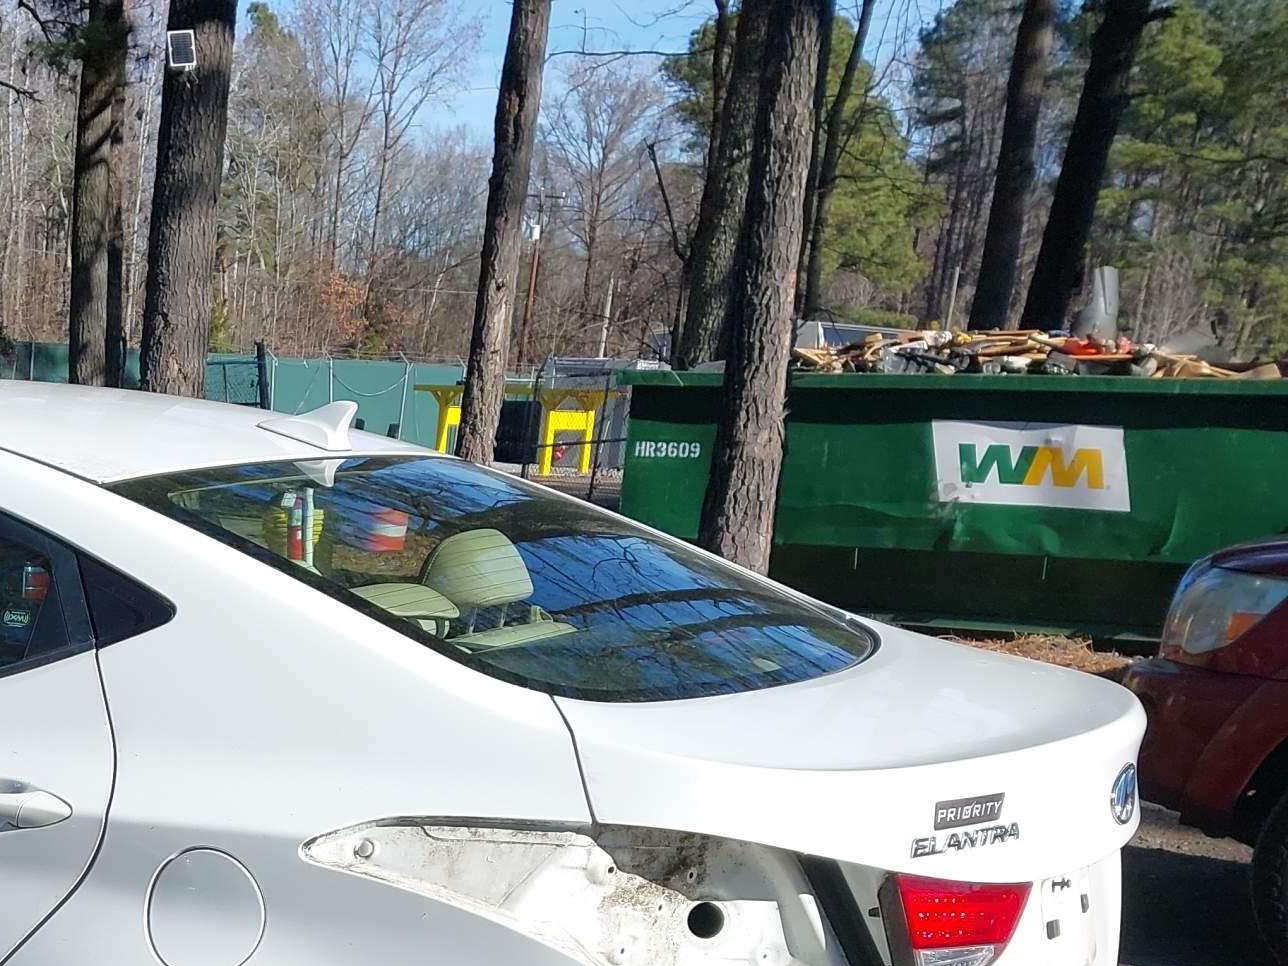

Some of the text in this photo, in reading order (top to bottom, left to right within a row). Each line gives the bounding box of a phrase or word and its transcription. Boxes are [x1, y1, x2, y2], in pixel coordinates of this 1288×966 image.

[634, 440, 701, 458] HR3609
[959, 443, 1105, 490] WM
[937, 799, 1002, 823] PRIORITY
[911, 822, 1020, 859] ELANTRA
